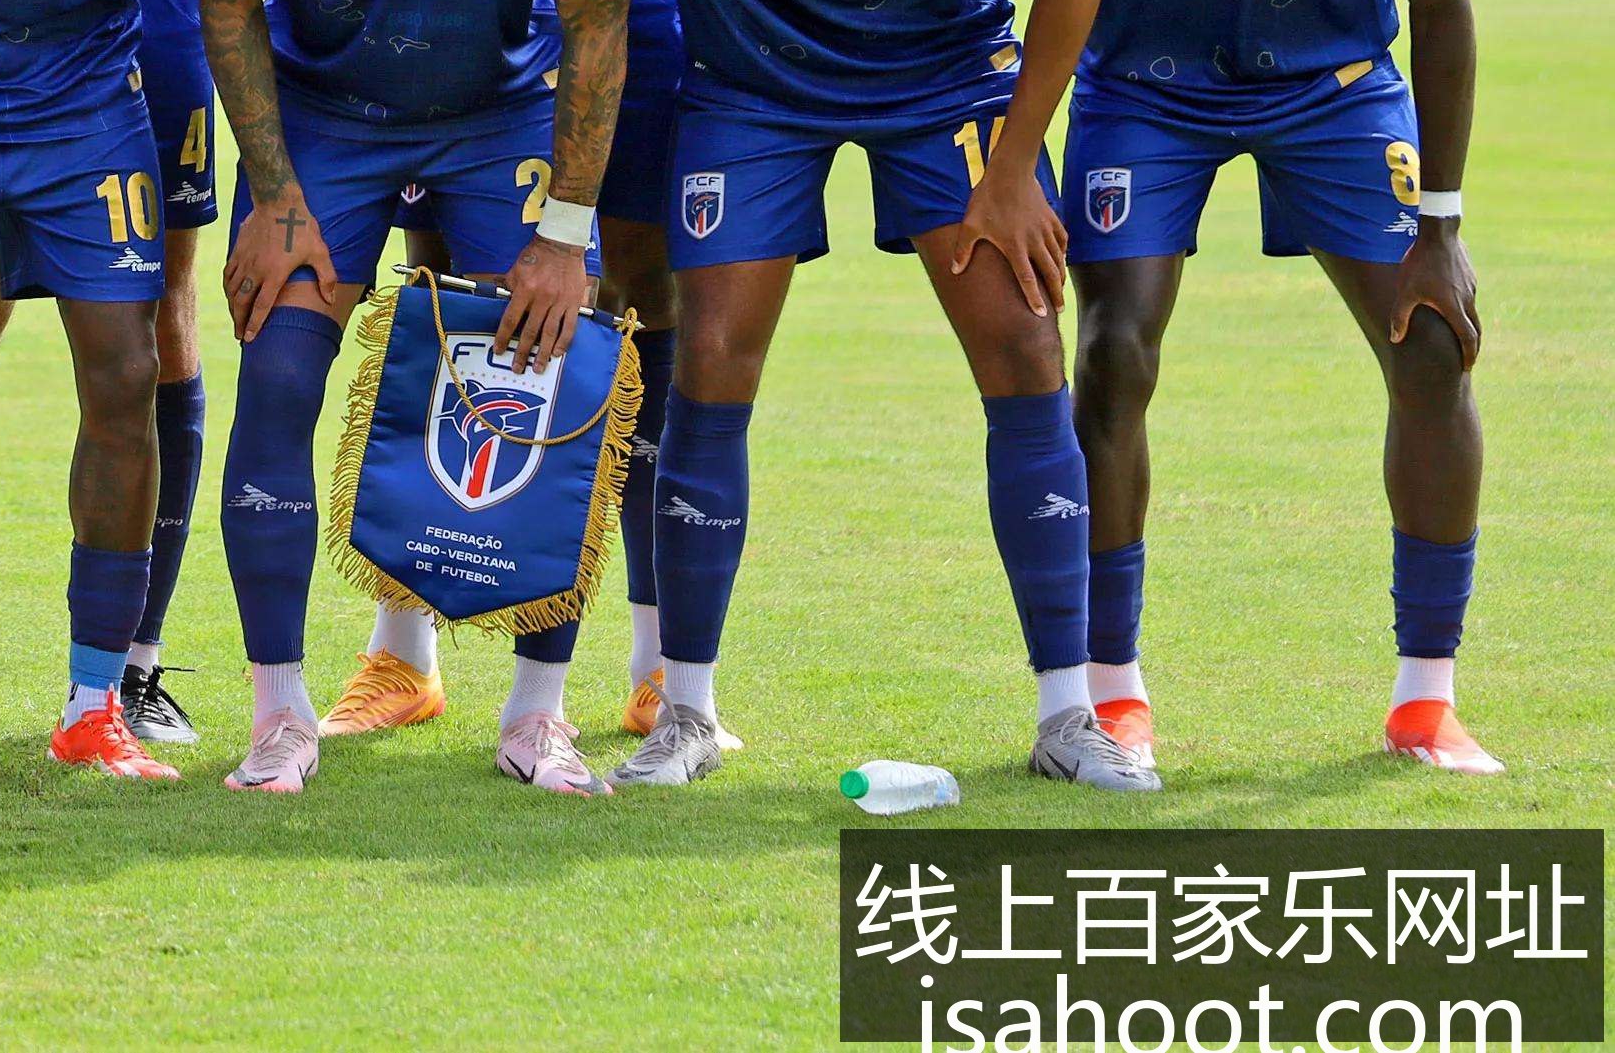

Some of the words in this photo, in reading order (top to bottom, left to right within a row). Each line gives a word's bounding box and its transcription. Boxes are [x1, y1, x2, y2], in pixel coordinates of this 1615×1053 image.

[179, 106, 208, 174] 4
[685, 176, 721, 189] FCF
[1089, 170, 1128, 184] FCF
[1385, 140, 1421, 207] 8
[96, 170, 159, 244] 10
[254, 500, 313, 514] tempo
[684, 515, 742, 531] tempo
[425, 525, 503, 550] FEDERAÇÃO
[405, 540, 517, 571] CABO-VERDIANA
[415, 560, 434, 573] DE
[440, 565, 500, 587] FUTEBOL
